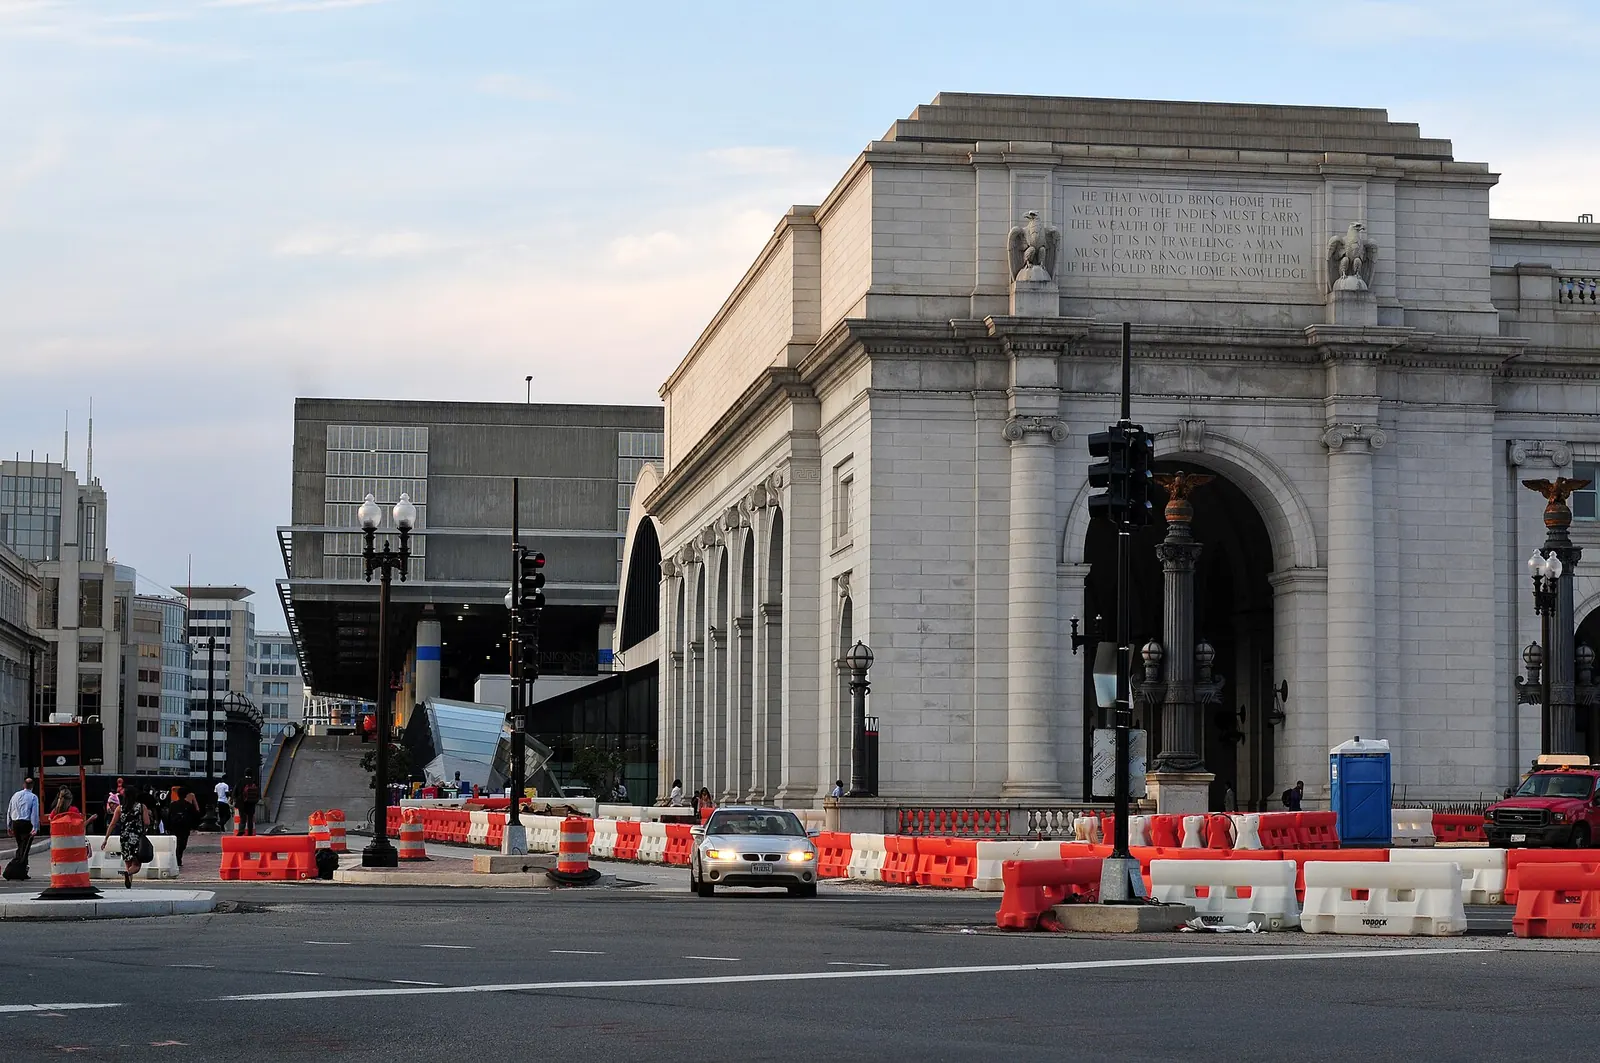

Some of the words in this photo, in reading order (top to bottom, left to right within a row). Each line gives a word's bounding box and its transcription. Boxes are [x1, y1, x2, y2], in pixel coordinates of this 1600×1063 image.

[1082, 191, 1097, 201] HE
[1103, 192, 1132, 202] THAT
[1138, 192, 1183, 204] WOULD
[1188, 194, 1224, 206] BRING
[1230, 196, 1264, 207] HOME
[1270, 198, 1292, 208] THE
[1072, 204, 1122, 216] WEALTH
[1128, 206, 1143, 216] OF
[1150, 208, 1171, 218] THE
[1178, 208, 1216, 219] INDIES
[1223, 210, 1256, 220] MUST
[1262, 212, 1302, 222] CARRY
[1070, 219, 1092, 229] THE
[1097, 220, 1148, 232] WEALTH
[1153, 222, 1168, 232] OF
[1174, 222, 1196, 232] THE
[1202, 224, 1240, 234] INDIES
[1246, 225, 1276, 236] WITH
[1282, 226, 1304, 236] HIM
[1092, 234, 1108, 244] SO
[1114, 234, 1123, 244] IT
[1128, 235, 1139, 245] IS
[1144, 236, 1156, 246] IN
[1162, 236, 1234, 248] TRAVELLING
[1244, 240, 1252, 249] A
[1256, 240, 1283, 250] MAN
[1074, 248, 1108, 258] MUST
[1114, 249, 1154, 260] CARRY
[1160, 250, 1236, 262] KNOWLEDGE
[1242, 253, 1272, 263] WITH
[1278, 254, 1300, 264] HIM
[1067, 262, 1077, 272] IF
[1082, 262, 1097, 272] HE
[1101, 262, 1146, 273] WOULD
[1151, 264, 1186, 275] BRING
[1192, 266, 1224, 276] HOME
[1230, 266, 1307, 278] KNOWLEDGE
